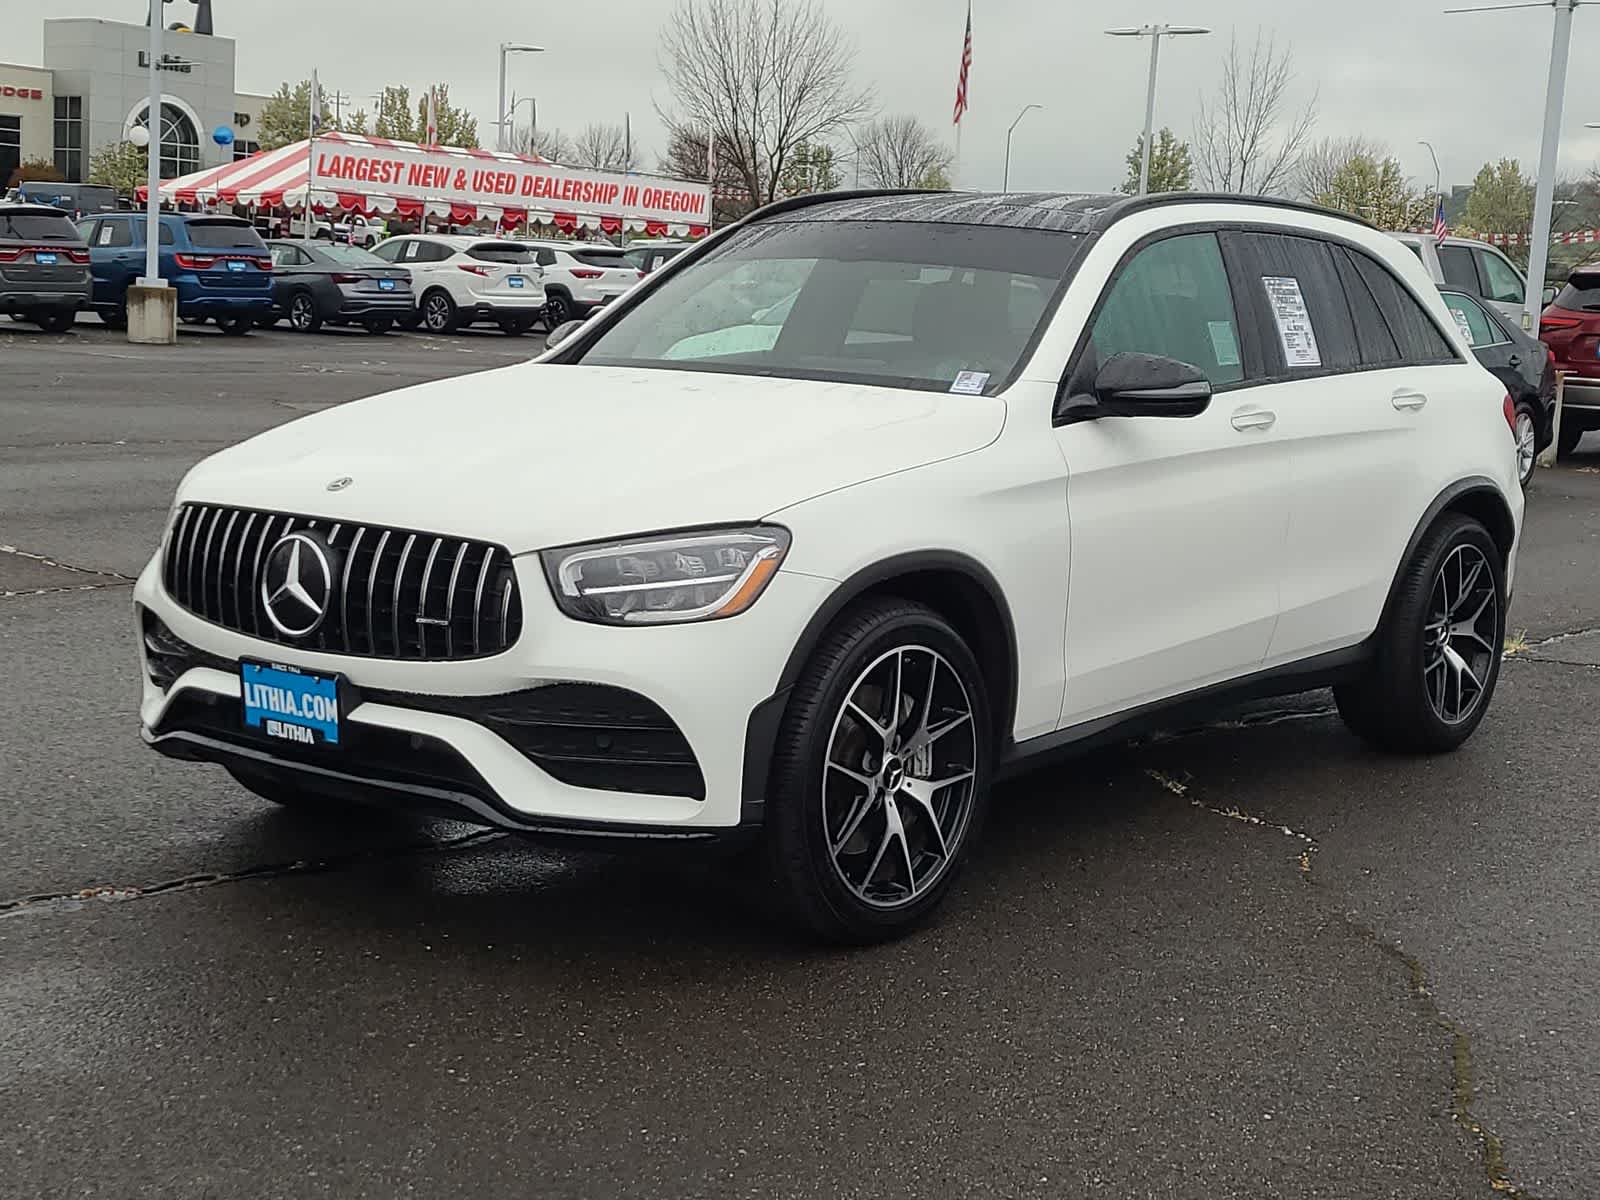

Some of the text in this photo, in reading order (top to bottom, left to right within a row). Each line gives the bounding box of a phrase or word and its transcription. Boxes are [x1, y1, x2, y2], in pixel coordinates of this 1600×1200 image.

[317, 154, 705, 214] LARGEST NEW & USED DEALERSHIP IN OREGON!
[244, 681, 338, 724] LITHIA.COM
[279, 722, 315, 744] LITHIA
